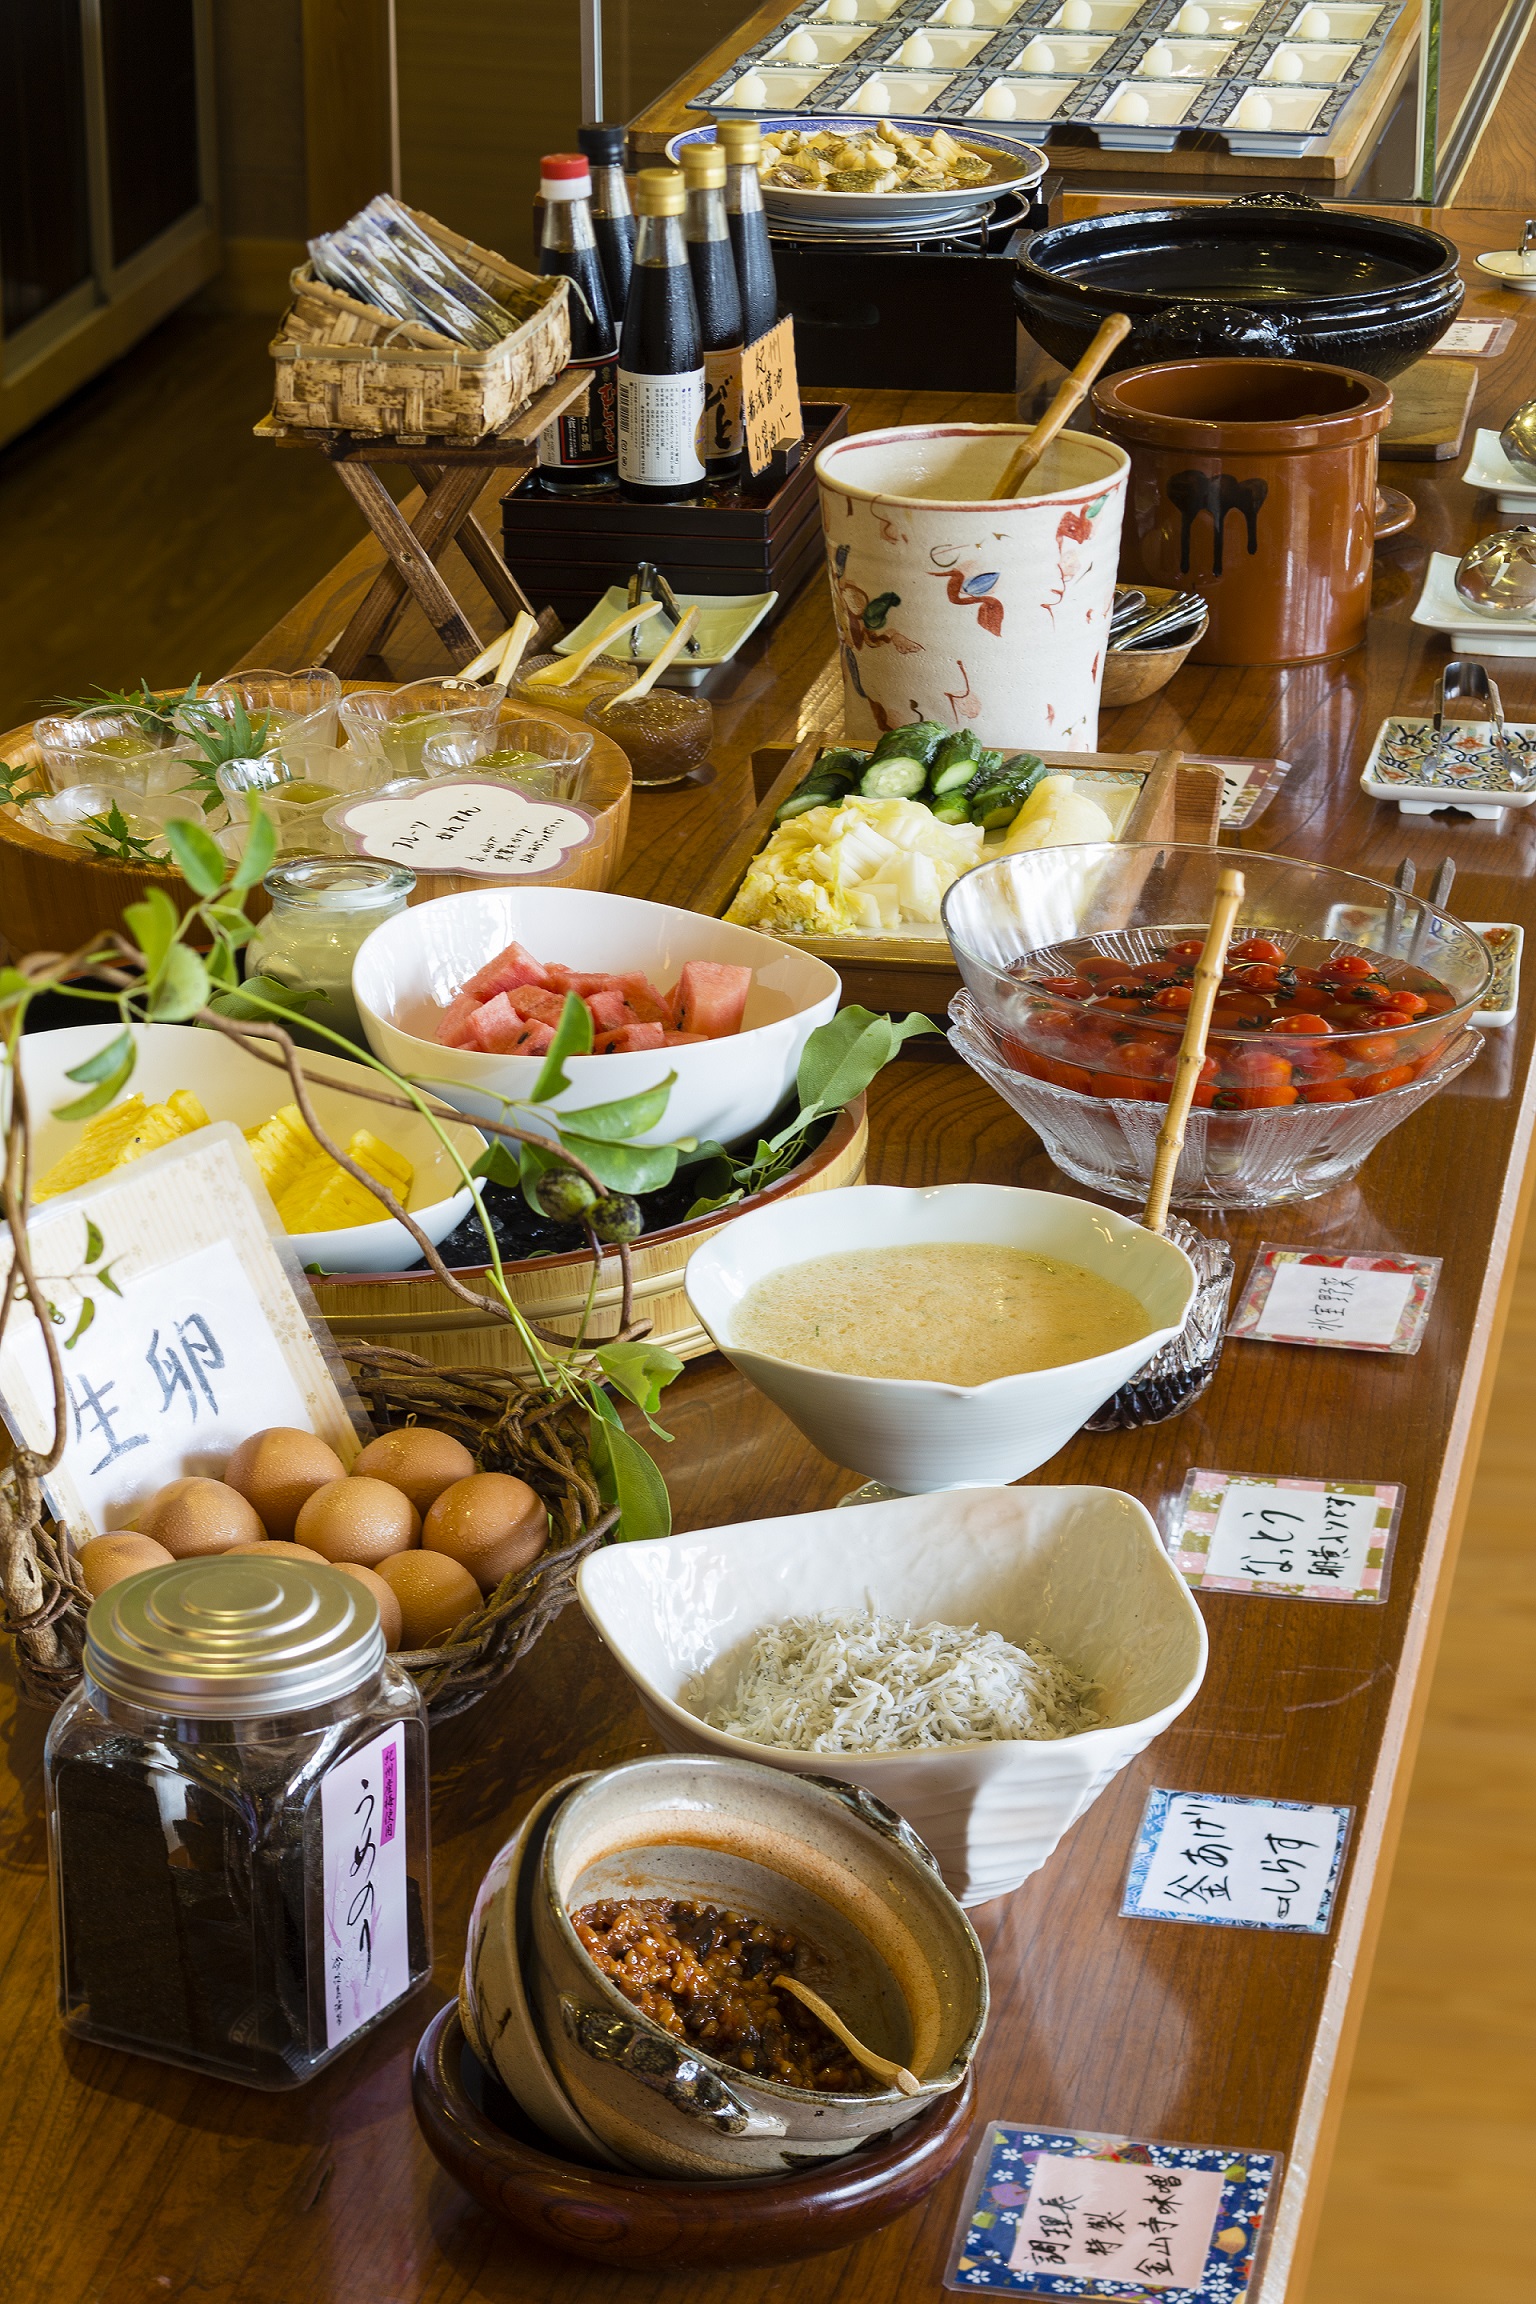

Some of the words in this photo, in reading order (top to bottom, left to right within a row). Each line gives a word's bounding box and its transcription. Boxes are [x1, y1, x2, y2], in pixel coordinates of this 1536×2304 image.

[392, 821, 431, 849] フルーツ
[63, 1312, 225, 1476] 生卵
[1241, 1509, 1305, 1576] なっとう
[1163, 1804, 1234, 1905] 釜あげ
[1261, 1833, 1320, 1894] しらす
[1023, 2195, 1083, 2266] 調理長
[1083, 2209, 1128, 2256] 特製
[1133, 2174, 1183, 2277] 金山寺味噌
